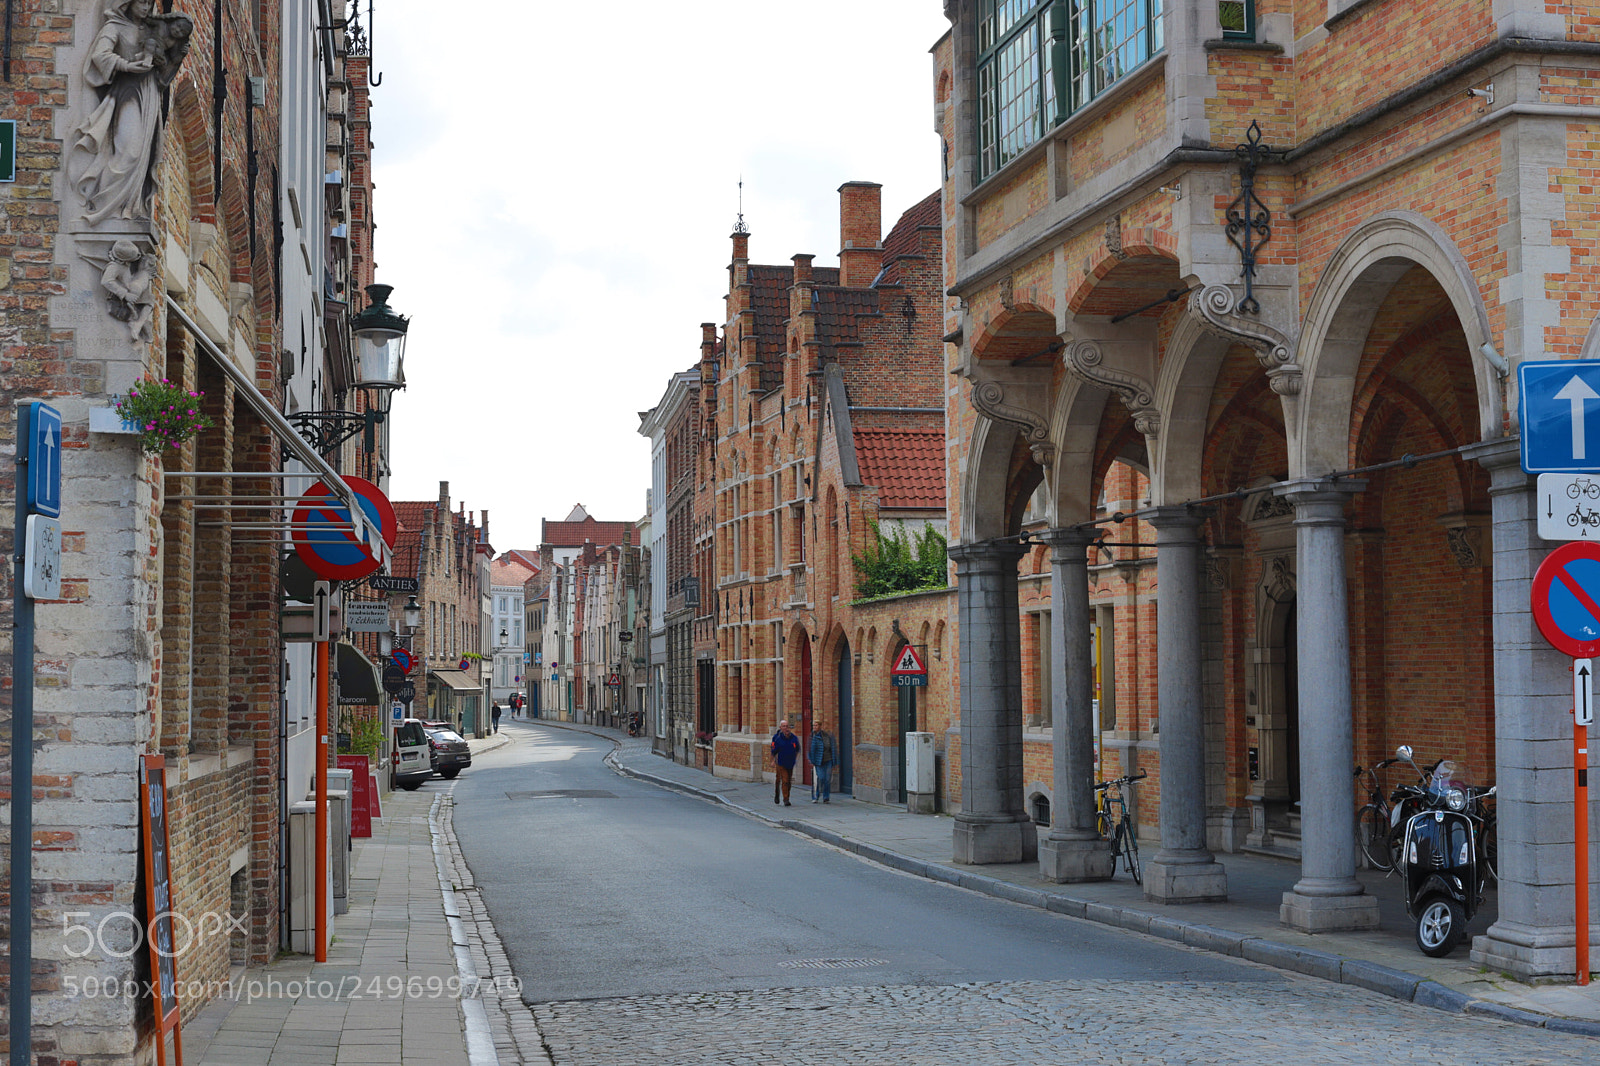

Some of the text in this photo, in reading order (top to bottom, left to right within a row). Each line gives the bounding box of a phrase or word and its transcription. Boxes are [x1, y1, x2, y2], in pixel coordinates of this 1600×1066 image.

[1581, 528, 1587, 536] A
[372, 578, 415, 590] ANTIEK
[898, 676, 910, 685] 50
